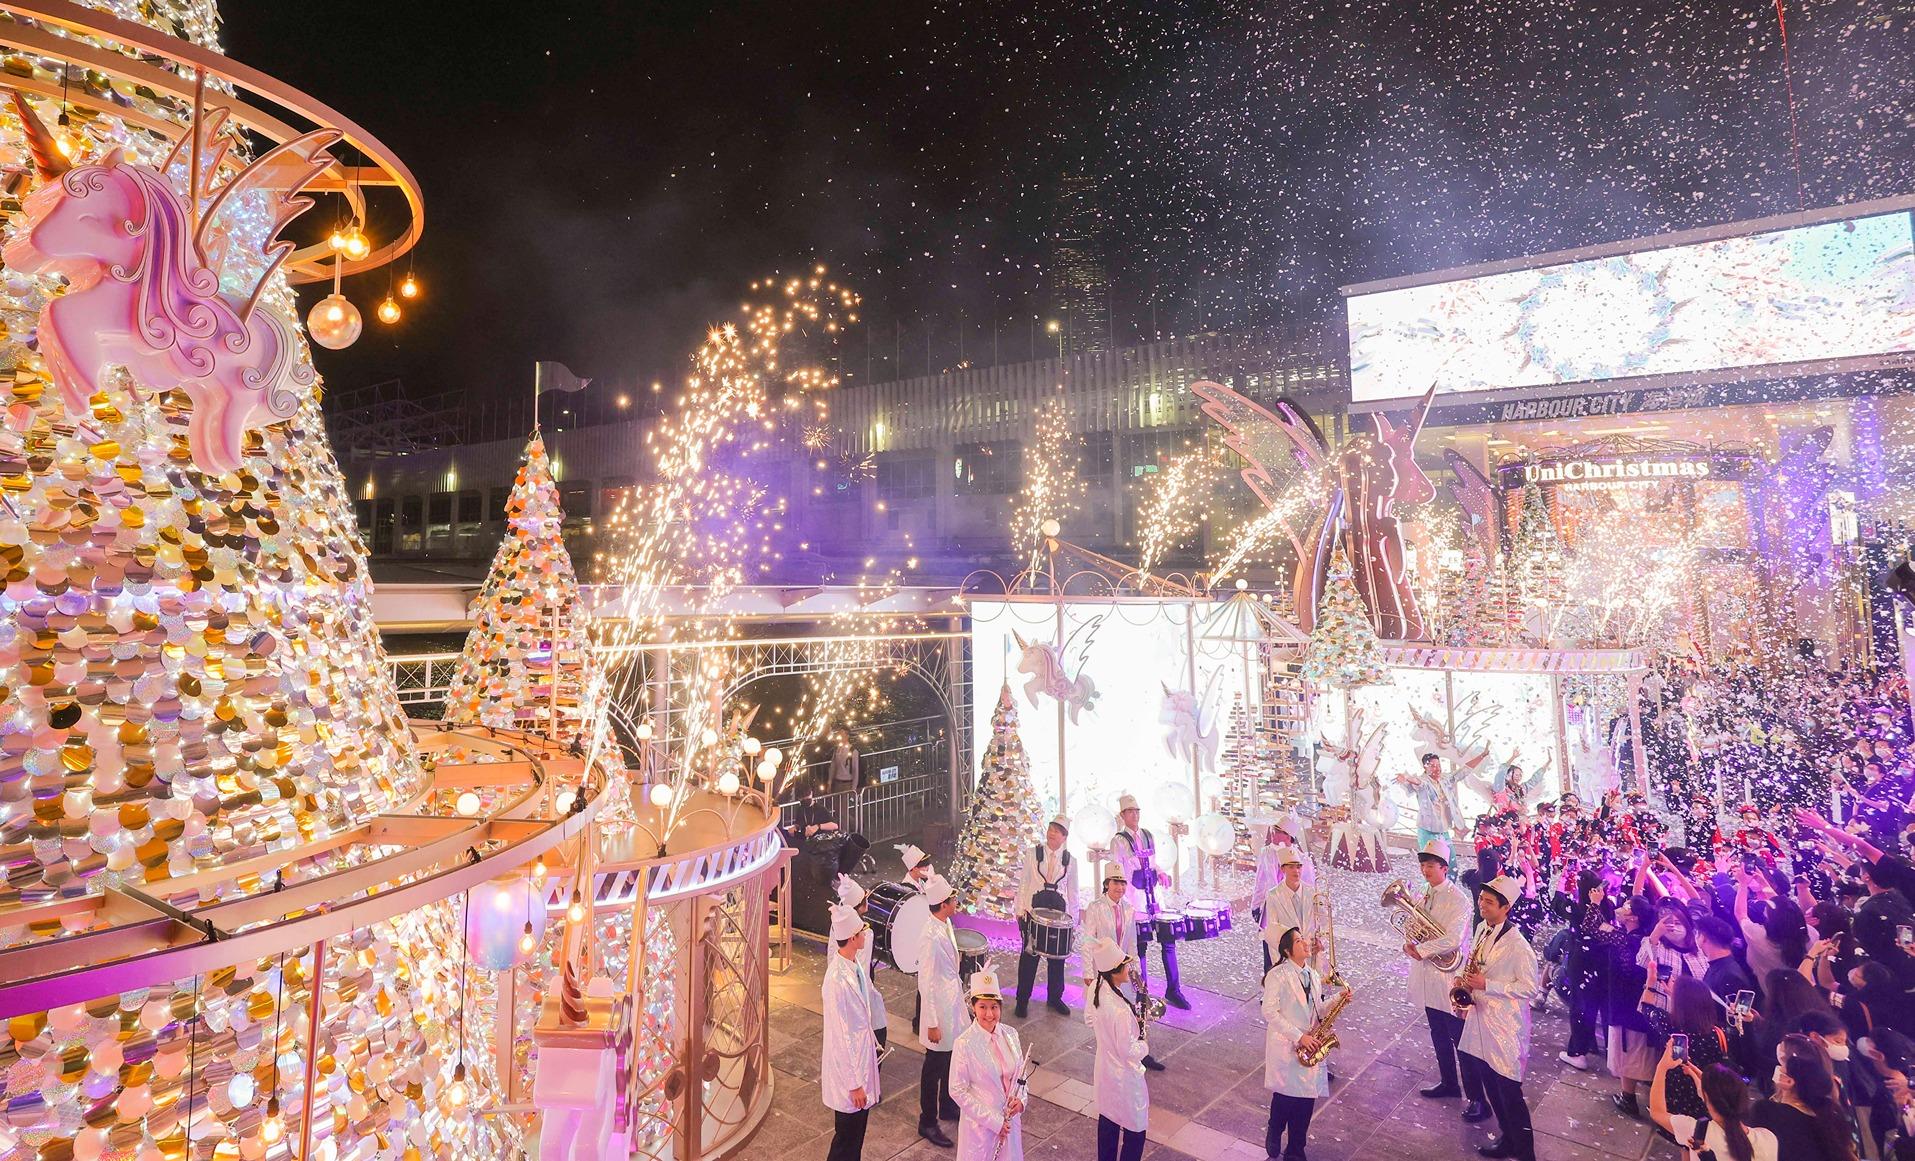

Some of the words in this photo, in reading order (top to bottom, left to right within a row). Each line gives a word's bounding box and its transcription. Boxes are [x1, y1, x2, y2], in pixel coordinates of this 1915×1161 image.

[1501, 397, 1586, 421] HARBOUR
[1589, 392, 1635, 414] CITY
[1524, 459, 1710, 482] UniChristmas
[1565, 482, 1625, 492] HARBOUR
[1627, 481, 1661, 490] CITY
